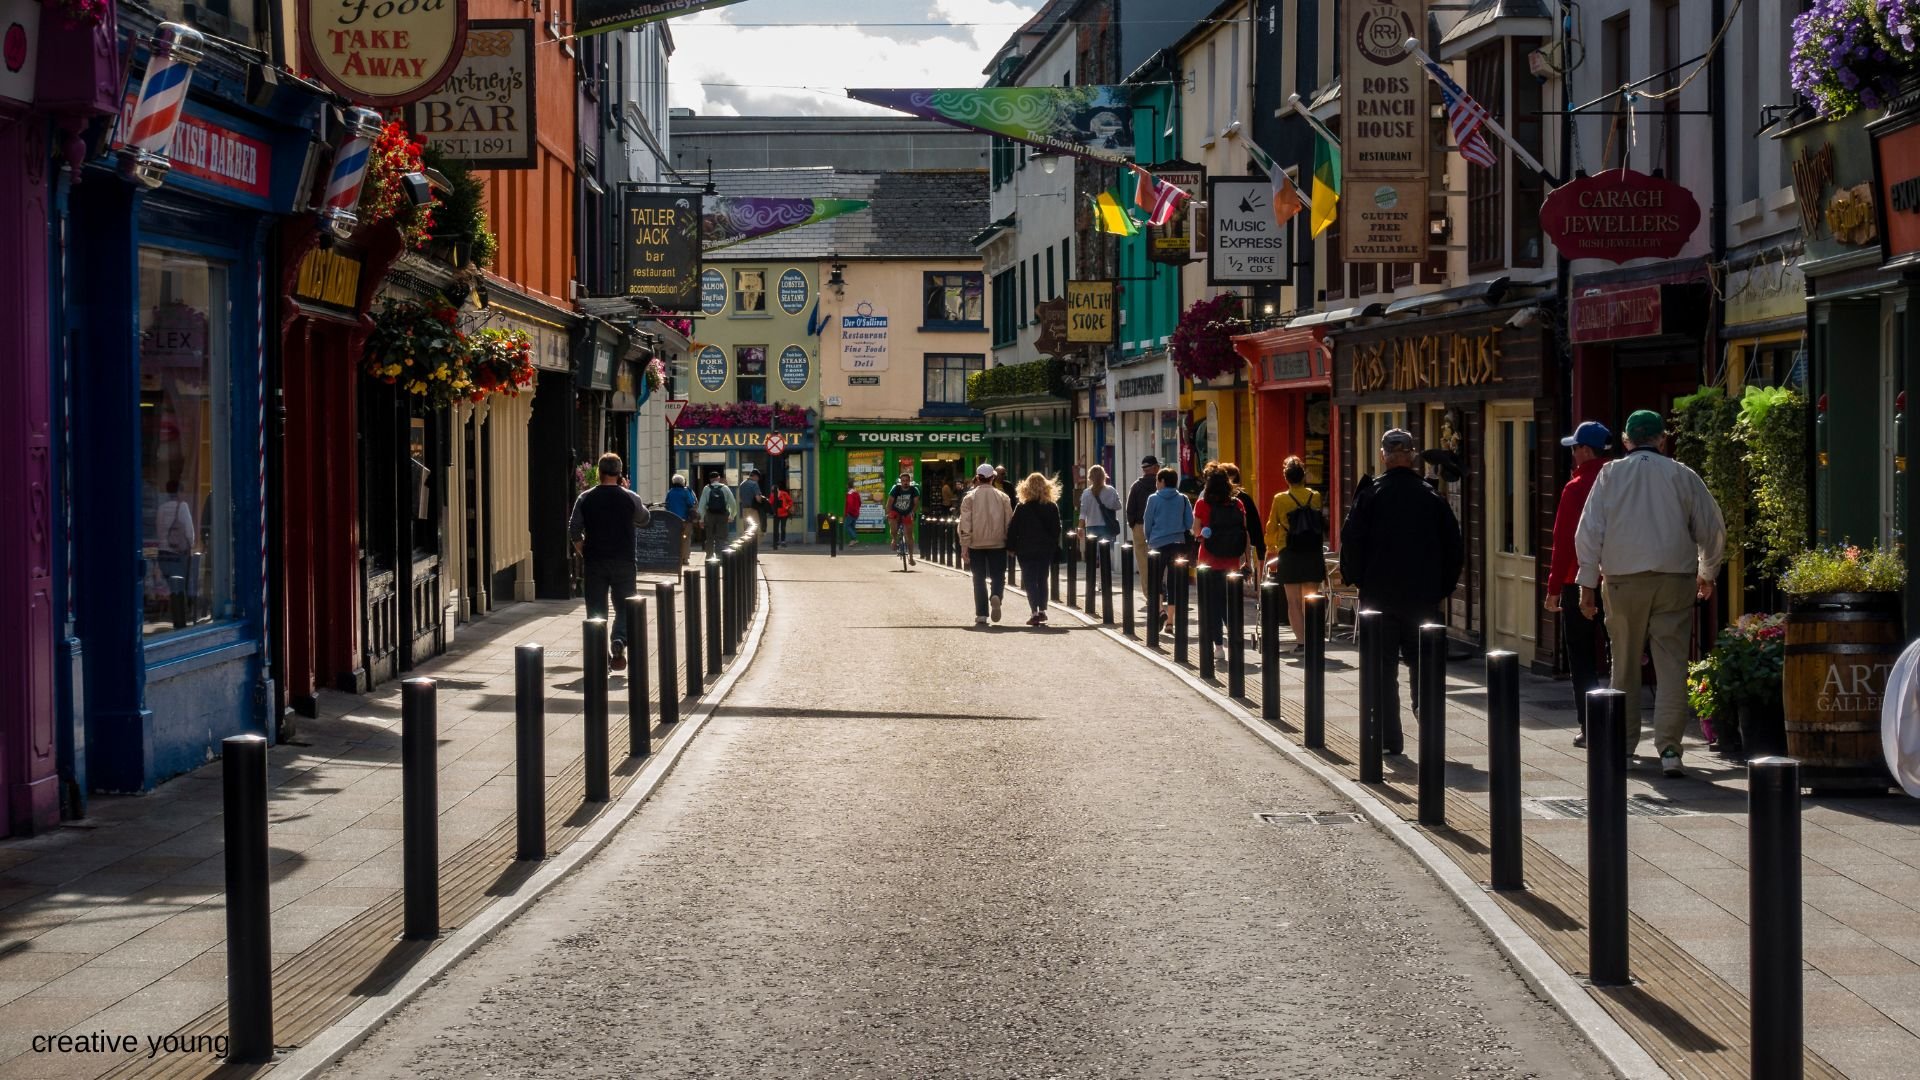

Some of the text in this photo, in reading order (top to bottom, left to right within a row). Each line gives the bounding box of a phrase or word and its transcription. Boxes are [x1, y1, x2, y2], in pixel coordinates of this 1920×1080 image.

[328, 29, 410, 54] TAKE
[341, 51, 428, 77] AWAY
[433, 67, 523, 104] urtney's
[1363, 77, 1409, 94] ROBS
[1358, 99, 1415, 116] RANCH
[421, 101, 519, 132] BAR
[1358, 121, 1416, 138] HOUSE
[172, 121, 208, 169] KISH
[211, 132, 257, 185] BARBER
[1026, 130, 1128, 164] The Town in The Park
[1359, 152, 1413, 161] RESTAURANT
[1160, 174, 1199, 185] NEILL'S
[1579, 189, 1664, 209] CARAGH
[631, 208, 676, 226] TATLER
[1361, 212, 1409, 221] GLUTEN
[1220, 218, 1266, 232] MUSIC
[1370, 223, 1401, 232] FREE
[1562, 215, 1680, 236] JEWELLERS
[636, 228, 670, 245] JACK
[1220, 235, 1283, 249] EXPRESS
[1368, 234, 1402, 243] MENU
[1579, 238, 1664, 249] IRISH JEWELLERY
[646, 250, 665, 262] bar
[1352, 245, 1419, 253] AVAILABLE
[1228, 255, 1244, 272] 1/2
[1247, 256, 1276, 264] PRICE
[633, 267, 676, 278] restaurant
[1249, 265, 1273, 273] CD'S
[629, 283, 679, 294] accommodation
[1068, 291, 1112, 310] HEALTH
[844, 318, 887, 327] Der O'Sullivan
[1072, 313, 1107, 330] STORE
[1577, 302, 1607, 331] CARAGH
[842, 331, 887, 340] Restaurant
[844, 345, 887, 353] Fine Foods
[854, 360, 875, 368] Deli
[1392, 335, 1440, 392] RANCH
[1447, 326, 1504, 387] HOUSE
[859, 432, 981, 443] TOURIST OFFICE
[1818, 663, 1895, 696] ART
